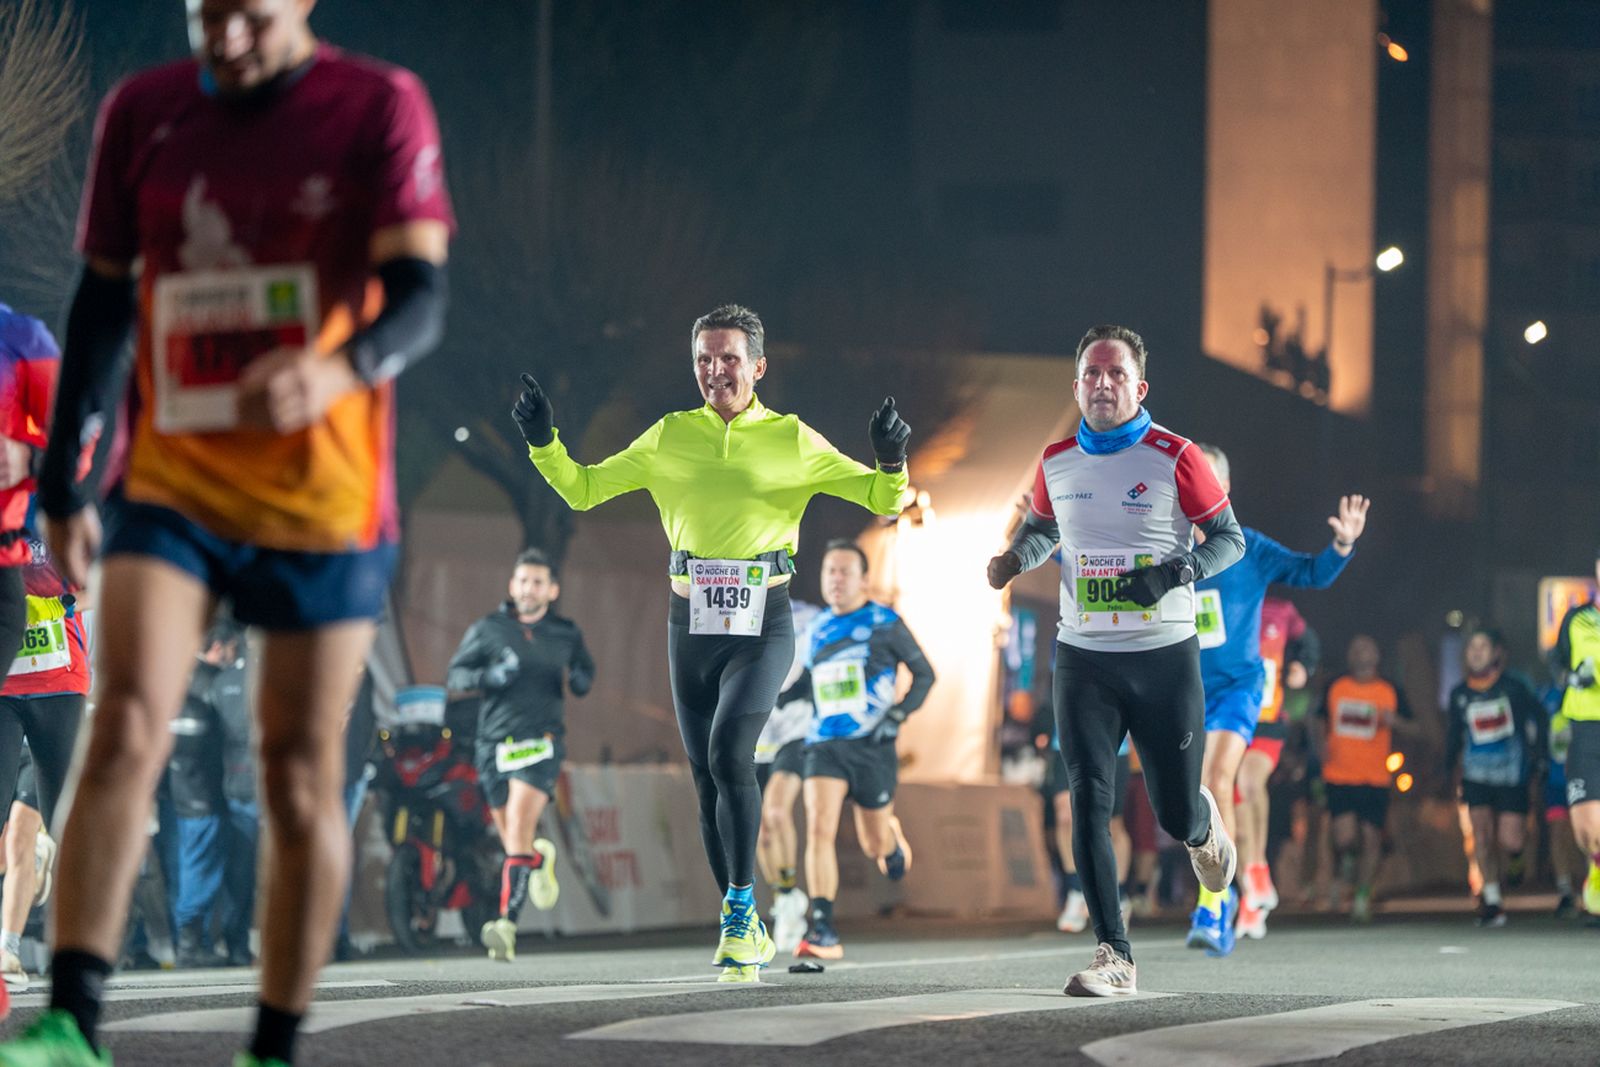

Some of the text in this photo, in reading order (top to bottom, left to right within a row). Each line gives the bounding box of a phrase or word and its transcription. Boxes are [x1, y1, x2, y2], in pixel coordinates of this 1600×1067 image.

[1089, 558, 1126, 566] NOCHE DE
[705, 568, 740, 576] NOCHE DE
[1081, 568, 1096, 577] SAN
[696, 576, 712, 585] SAN
[703, 587, 751, 609] 1439
[19, 627, 49, 651] 63
